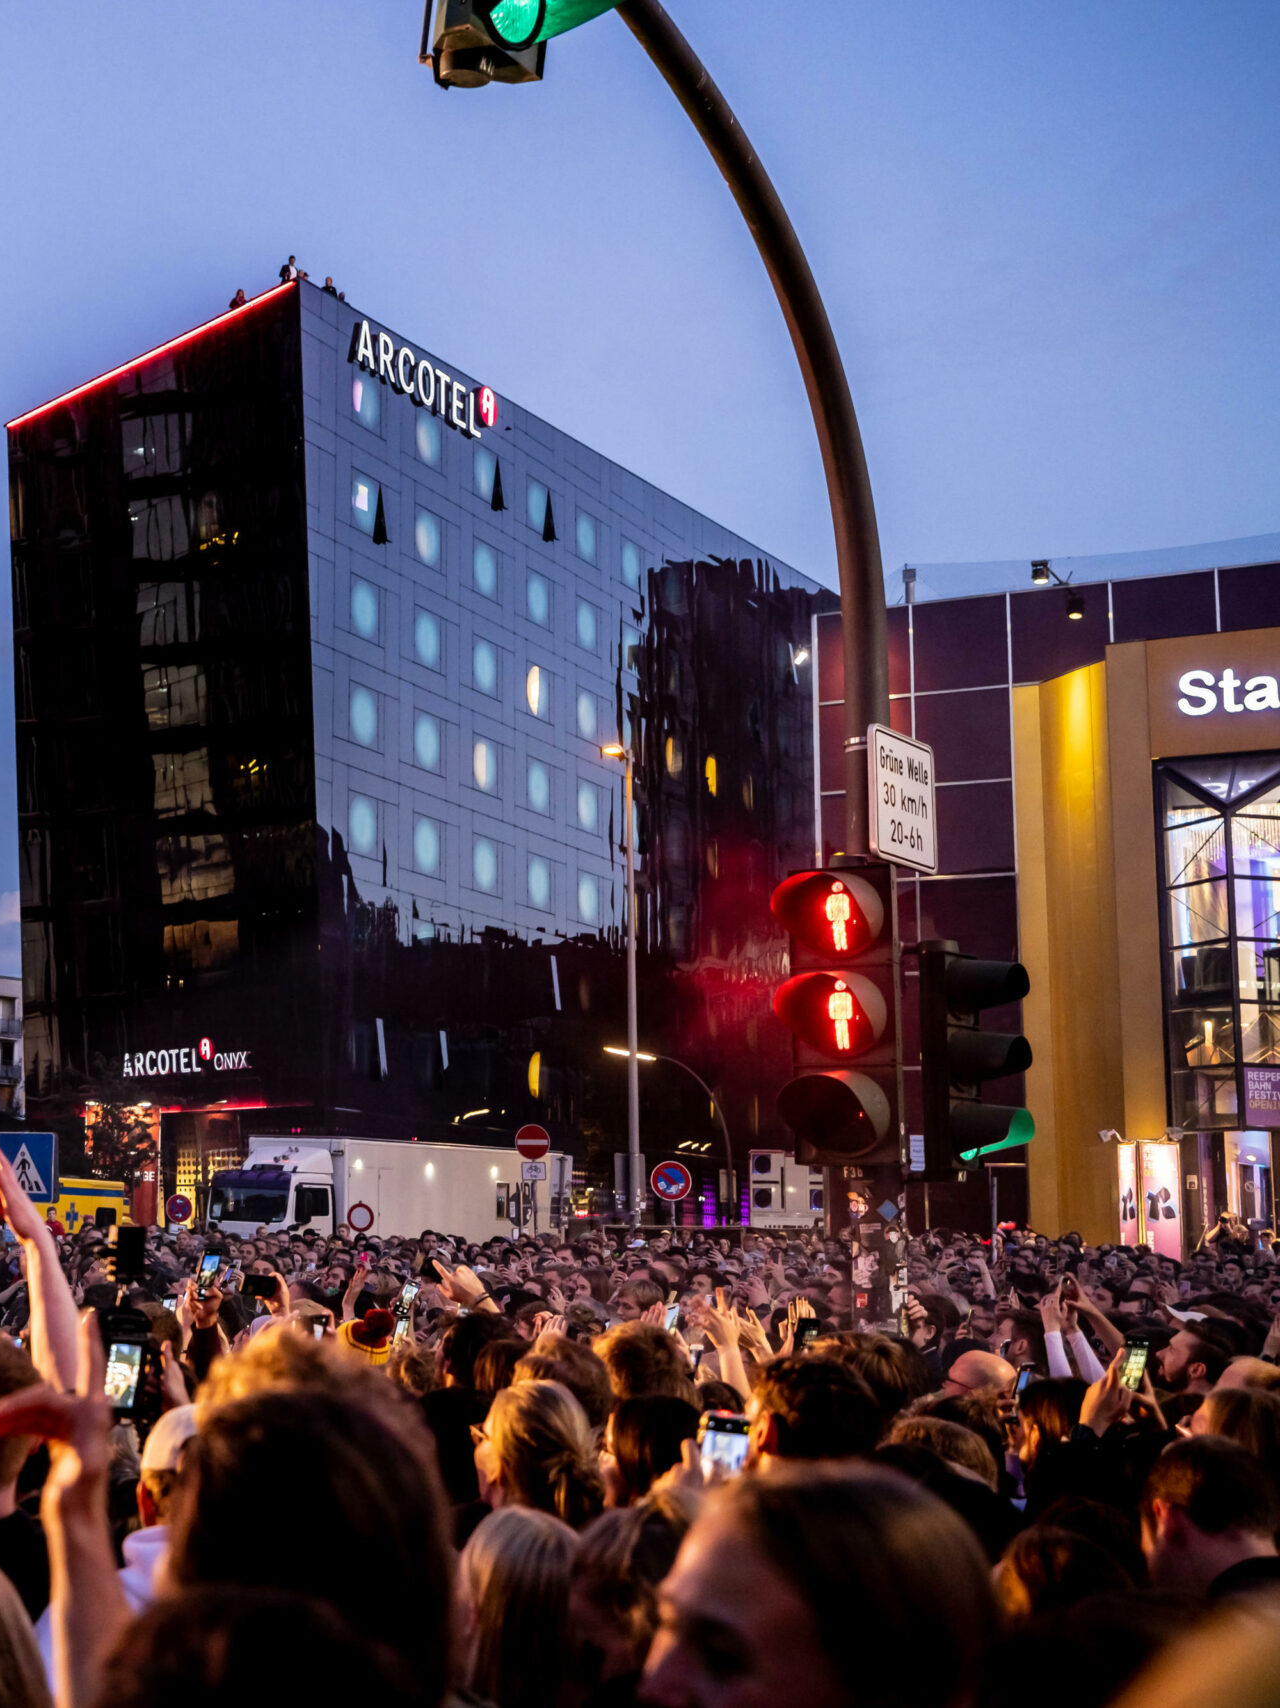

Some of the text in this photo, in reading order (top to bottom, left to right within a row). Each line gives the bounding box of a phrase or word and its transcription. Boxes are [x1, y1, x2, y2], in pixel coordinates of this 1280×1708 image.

[357, 320, 482, 439] ARCOTEL
[1177, 668, 1280, 716] Sta
[879, 745, 929, 786] Grüne Welle
[883, 782, 928, 819] 30 km/h
[890, 819, 923, 851] 20-6h
[122, 1048, 202, 1078] ARCOTEL
[213, 1051, 249, 1071] ONYX
[1248, 1081, 1272, 1090] BAHN
